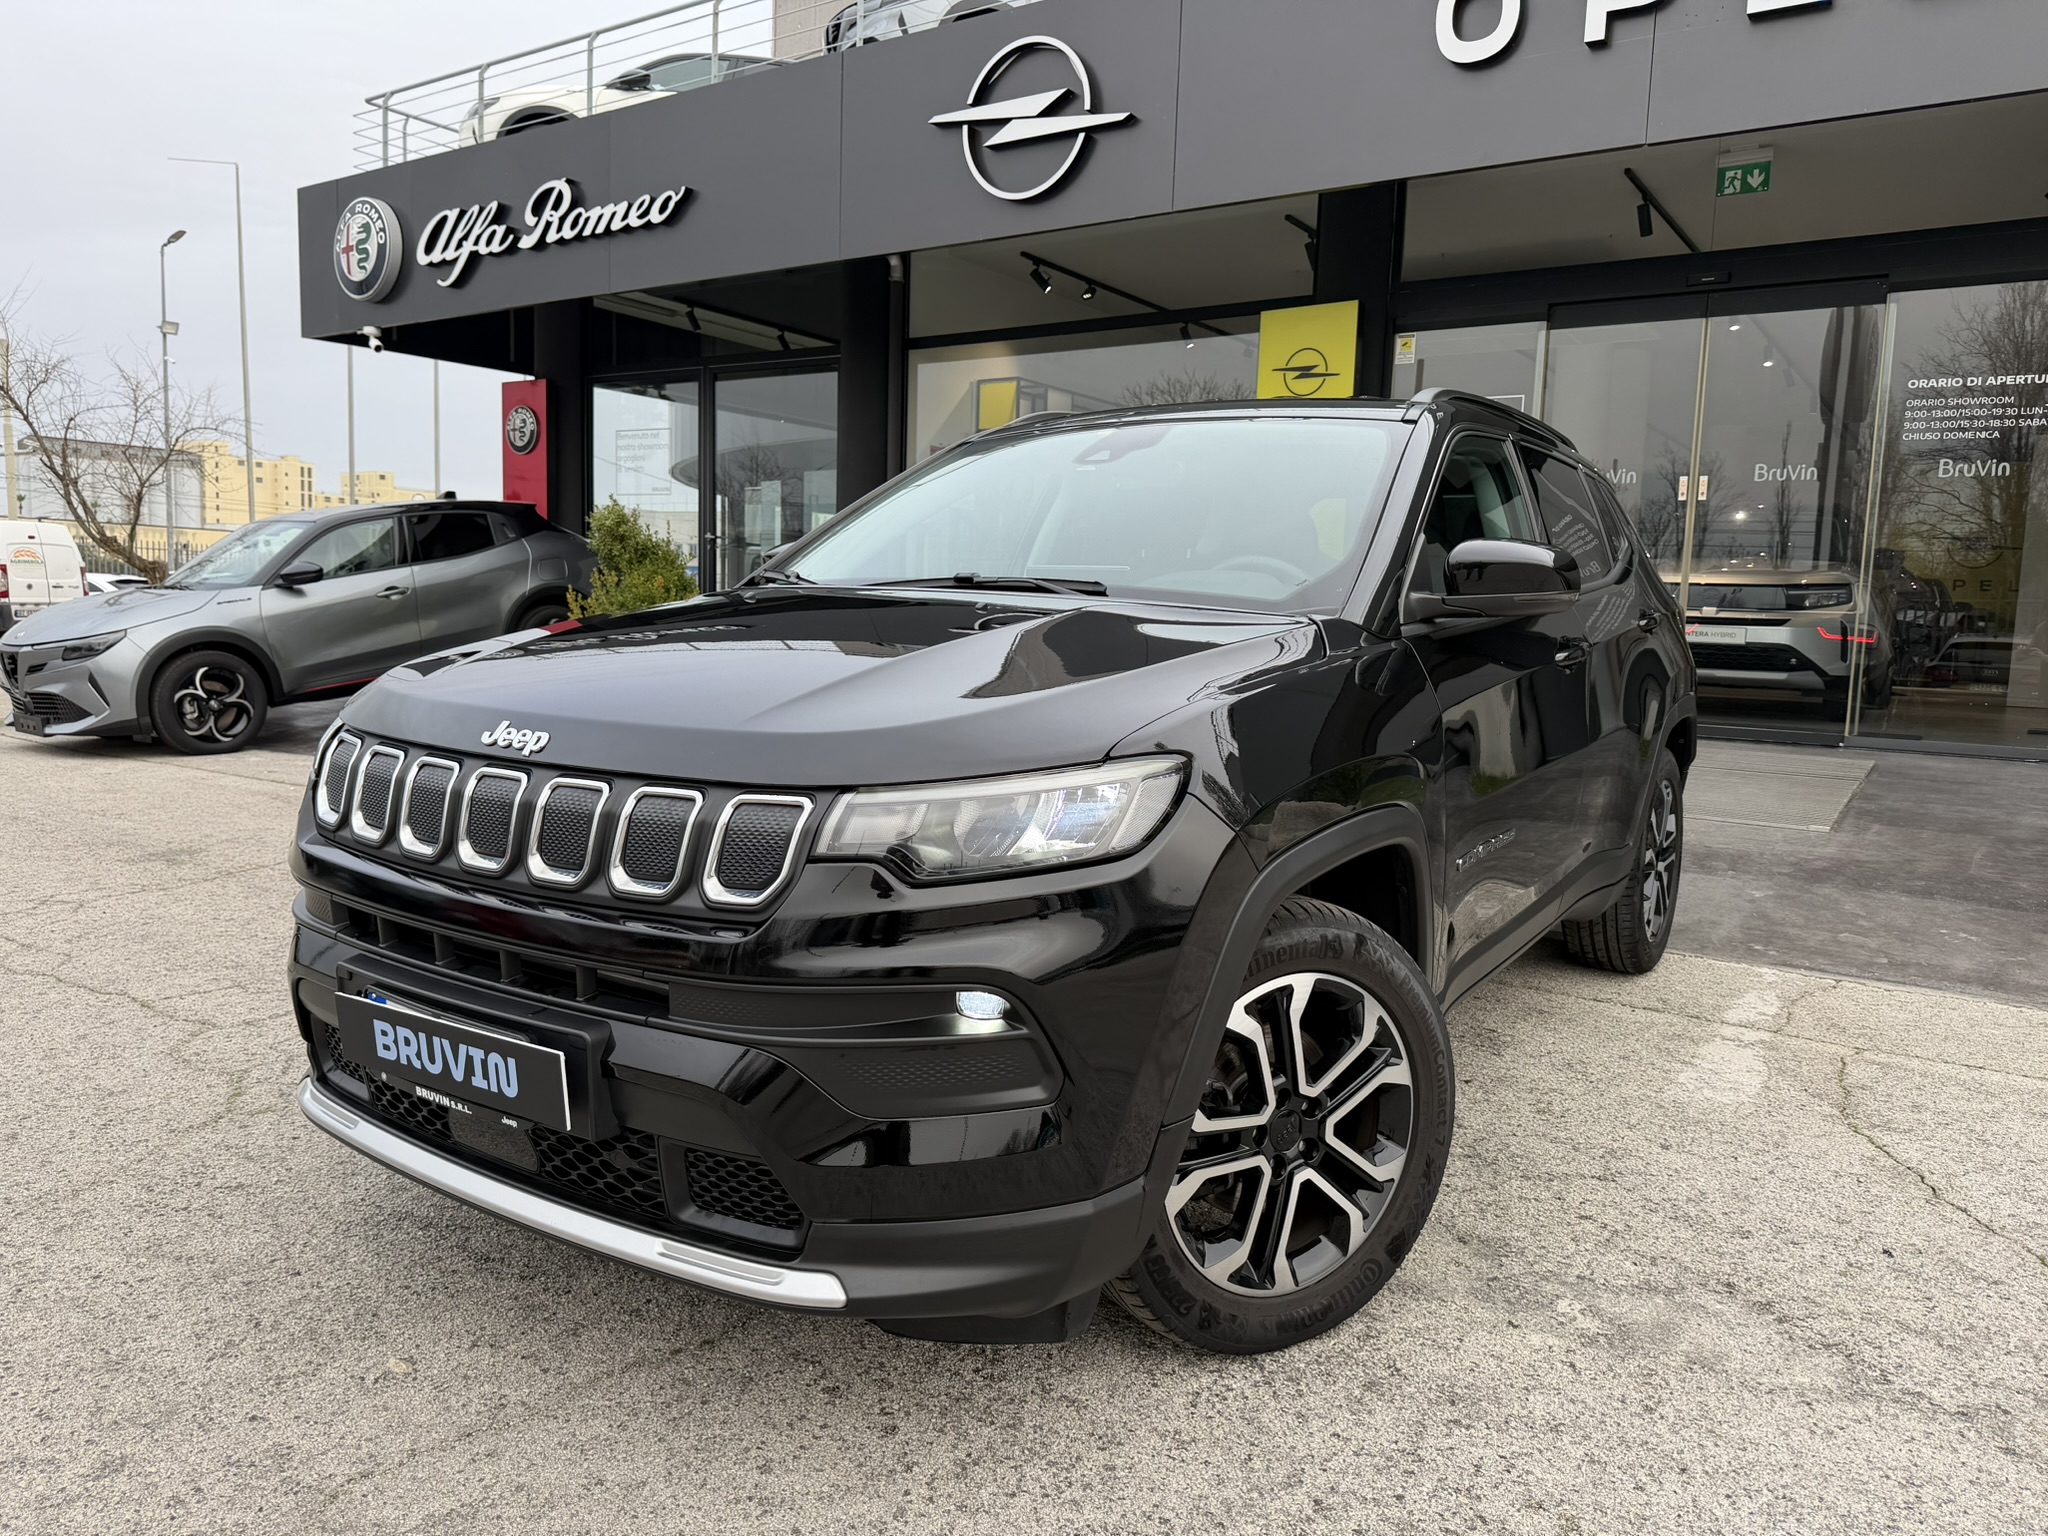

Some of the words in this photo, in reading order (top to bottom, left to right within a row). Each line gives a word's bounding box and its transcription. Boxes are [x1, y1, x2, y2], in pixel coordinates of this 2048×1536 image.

[355, 203, 386, 245] ROMEO
[417, 201, 513, 287] Alfa
[517, 178, 686, 249] Romeo
[1908, 377, 1963, 389] ORARIO
[1967, 376, 1982, 386] DI
[1985, 374, 2048, 386] APERTU
[1906, 398, 1946, 407] ORARIO
[1948, 395, 2014, 406] SHOWROOM
[2018, 418, 2048, 427] SABA
[1902, 432, 1941, 440] CHIUSO
[1942, 430, 2000, 439] DOMENICA
[1606, 468, 1637, 484] Vin
[1753, 463, 1818, 482] BruVin
[1937, 459, 2011, 478] BruVin
[1952, 579, 2019, 592] PEL
[1710, 631, 1737, 639] HYBRID
[481, 720, 550, 757] Jeep
[373, 1019, 518, 1097] BRUVIN
[415, 1085, 450, 1107] BRUVIN
[450, 1100, 473, 1115] S.R.L.
[501, 1115, 518, 1129] Jeep
